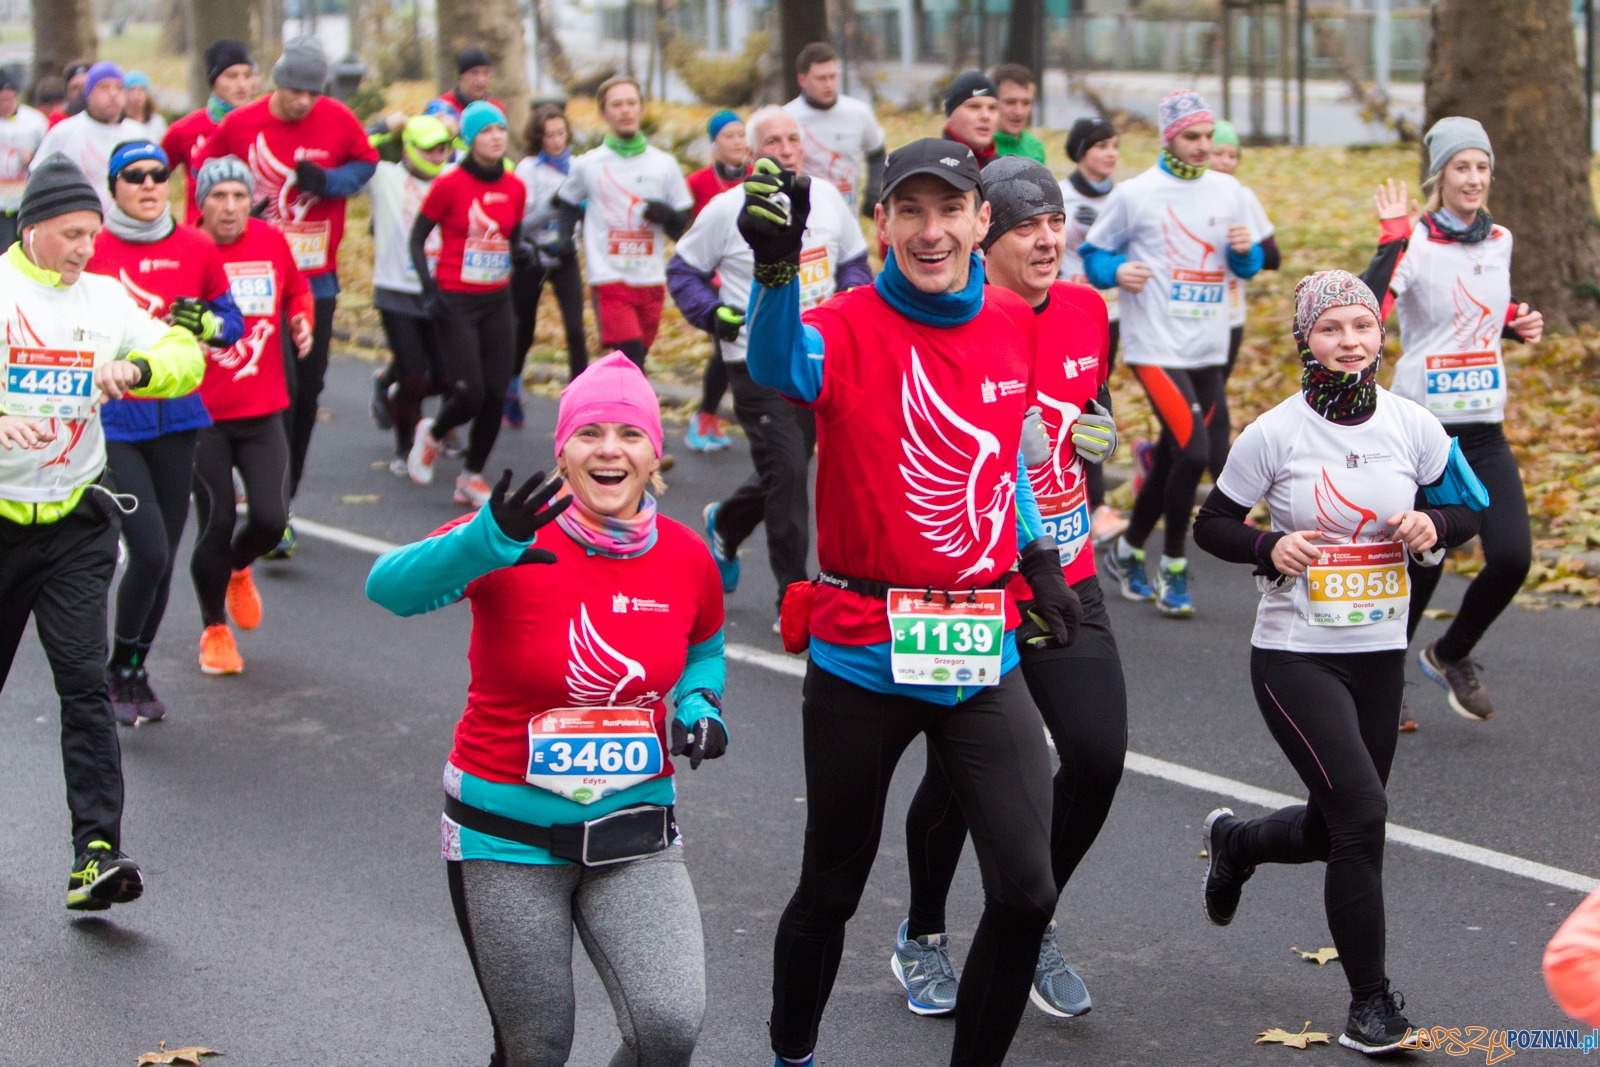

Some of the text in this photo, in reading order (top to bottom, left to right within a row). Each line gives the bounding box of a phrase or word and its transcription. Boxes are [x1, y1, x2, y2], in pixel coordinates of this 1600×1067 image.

[939, 157, 961, 168] 4F
[618, 241, 647, 256] 594
[802, 262, 825, 284] 76
[1179, 284, 1221, 302] 5717
[10, 369, 89, 396] E 4487
[1436, 369, 1494, 392] 9460
[1043, 511, 1082, 542] 959
[1312, 570, 1399, 598] D 8958
[910, 621, 993, 653] 1139
[933, 657, 966, 666] Grzegorz
[602, 719, 650, 728] RunPoland.org
[534, 741, 649, 772] E 3460
[583, 778, 607, 786] Edyta
